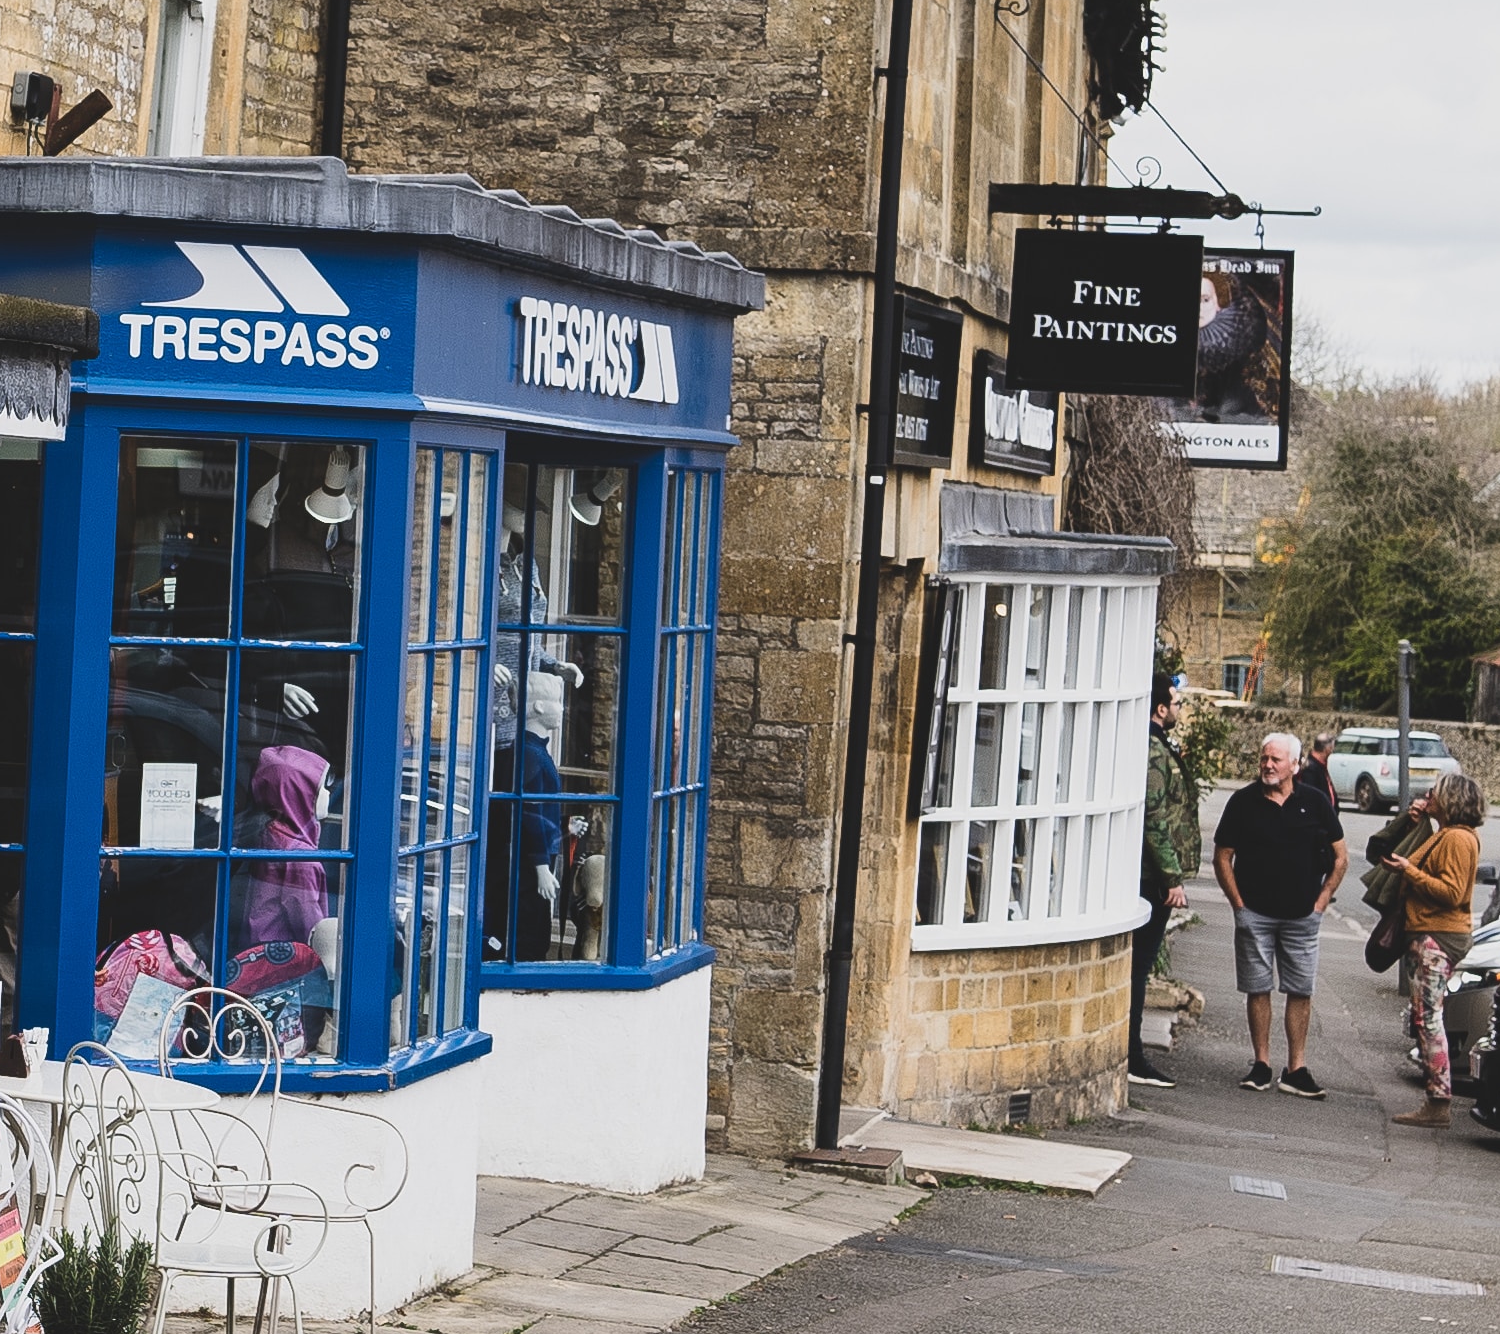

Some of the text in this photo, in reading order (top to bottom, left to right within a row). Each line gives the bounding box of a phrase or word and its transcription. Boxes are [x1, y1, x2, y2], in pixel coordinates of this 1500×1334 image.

[1073, 280, 1141, 307] FINE
[1032, 314, 1177, 344] PAINTINGS
[1179, 435, 1270, 448] NGTON ALES
